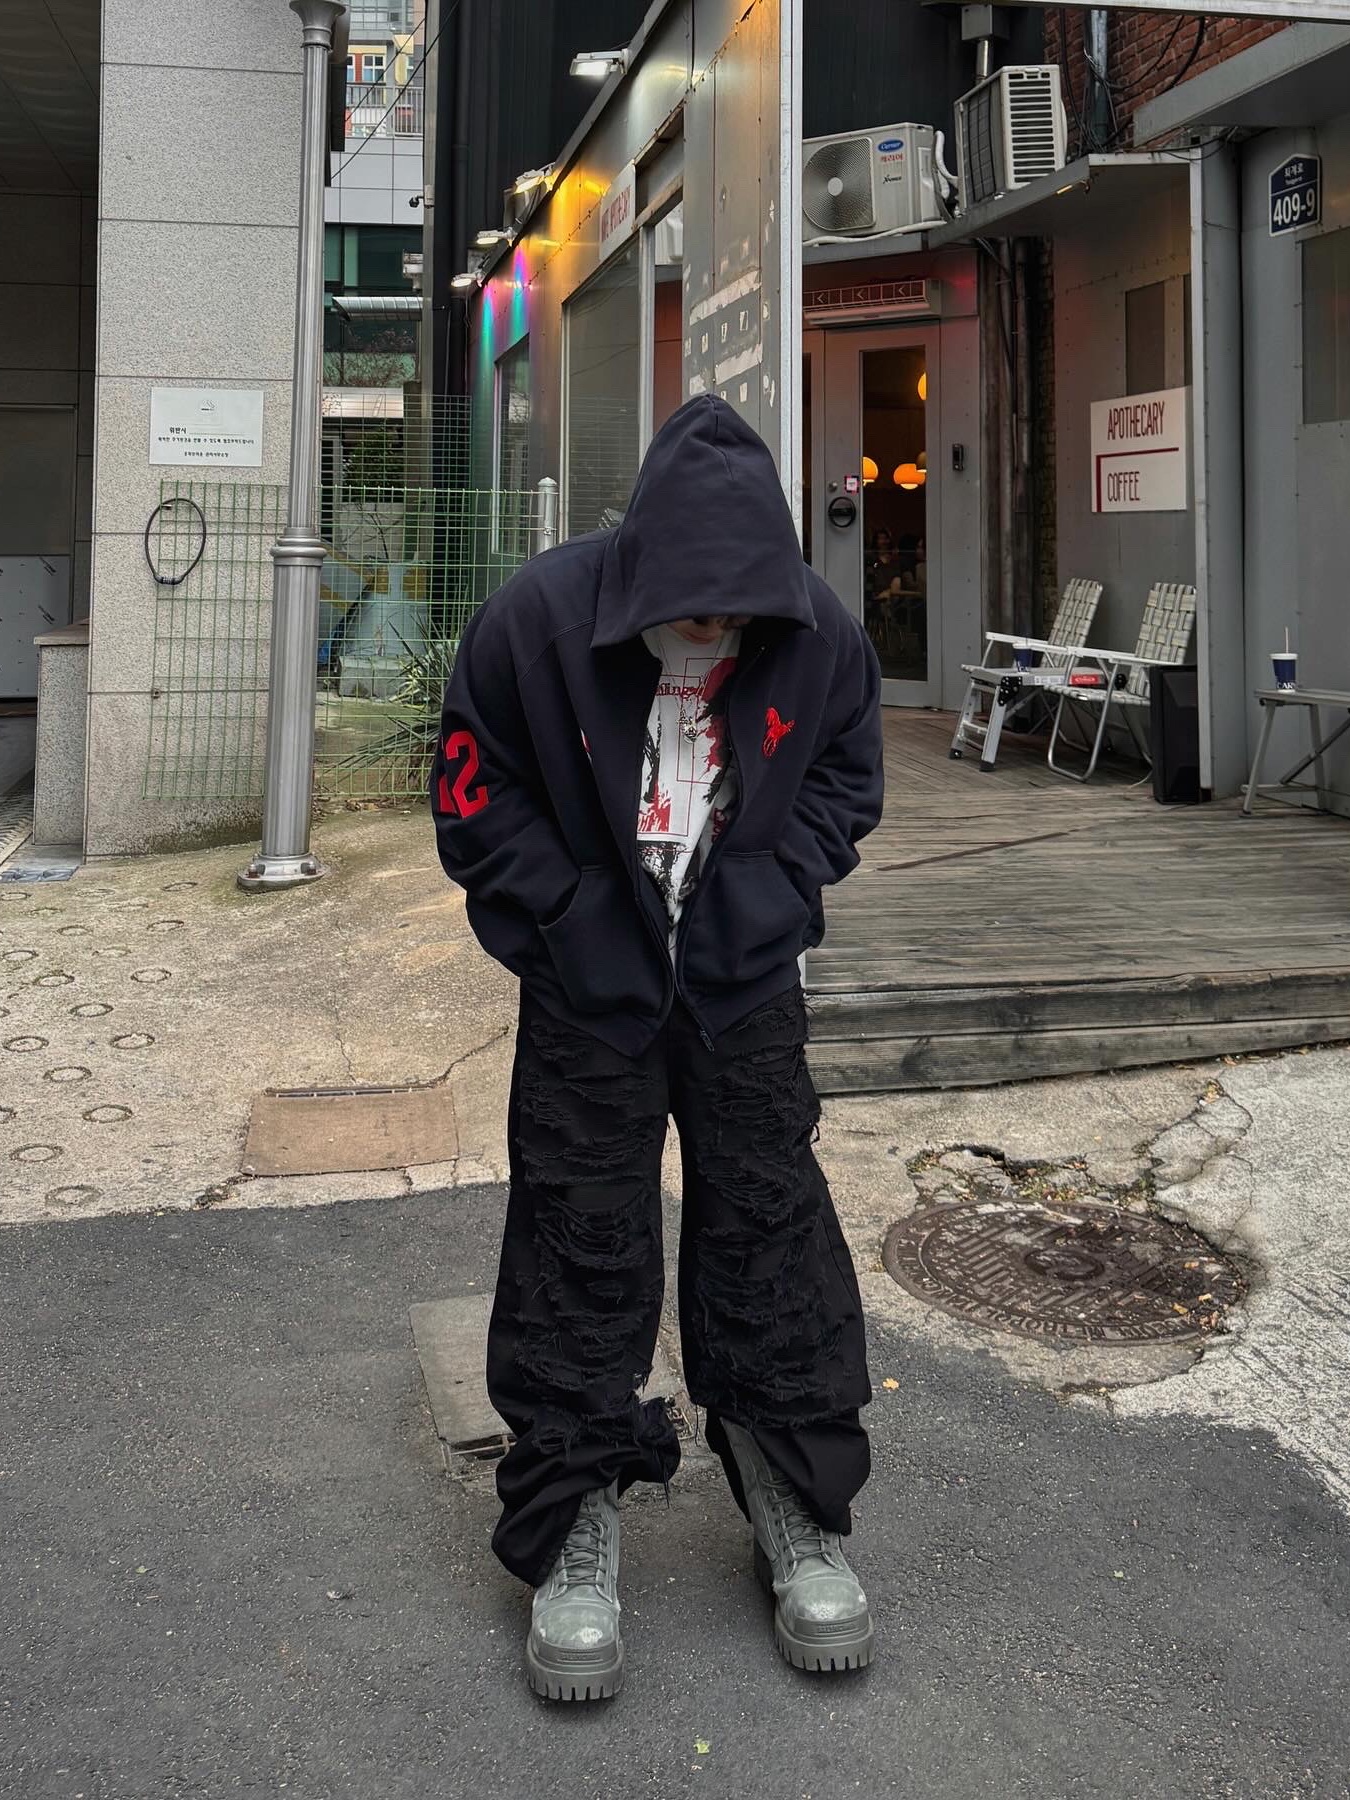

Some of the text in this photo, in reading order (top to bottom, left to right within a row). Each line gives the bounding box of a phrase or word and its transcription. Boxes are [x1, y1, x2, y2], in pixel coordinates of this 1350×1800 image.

[1273, 188, 1316, 226] 409-9
[169, 426, 187, 434] 위반시
[1107, 400, 1165, 441] APOTHECARY
[1107, 471, 1141, 502] COFFEE
